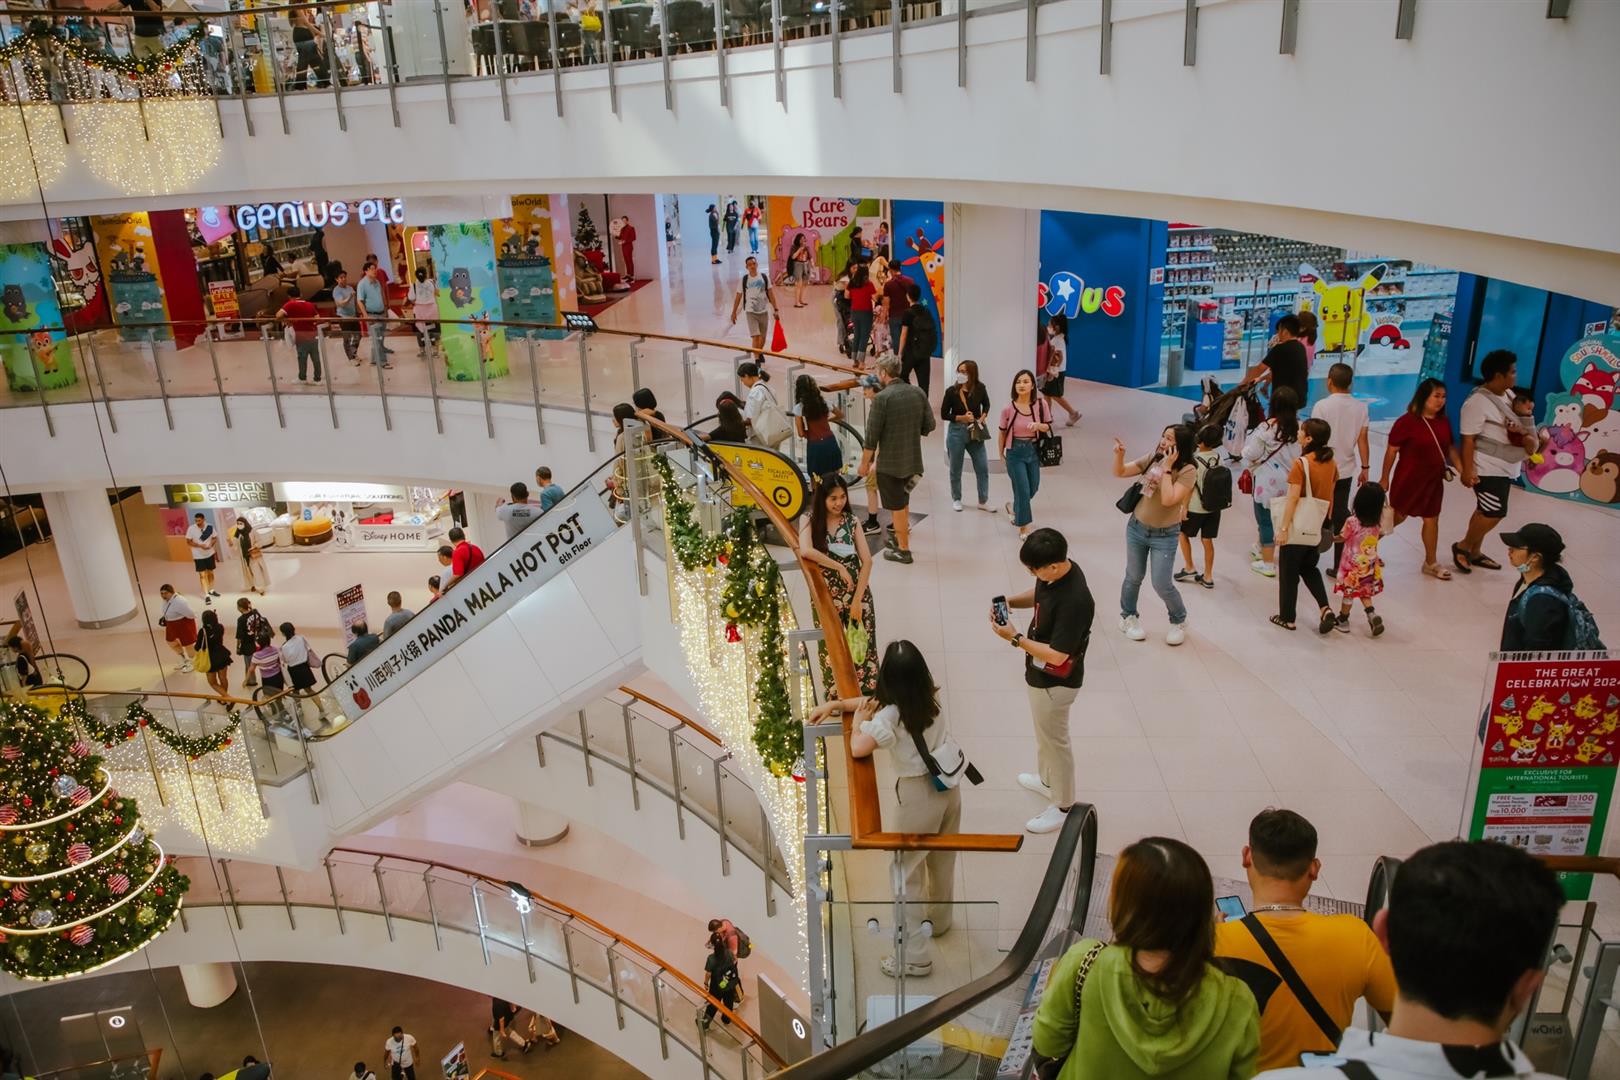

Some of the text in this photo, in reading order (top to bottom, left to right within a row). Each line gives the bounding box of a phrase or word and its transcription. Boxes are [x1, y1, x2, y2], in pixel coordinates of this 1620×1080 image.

[809, 196, 845, 214] Care
[802, 211, 848, 229] Bears
[207, 482, 266, 492] DESIGN
[208, 492, 270, 502] SQUARE
[390, 532, 421, 541] HOME
[558, 538, 593, 565] 6th Floor
[417, 608, 468, 652] PANDA
[463, 572, 514, 616] MALA
[509, 541, 547, 583] HOT
[545, 512, 585, 554] POT
[1535, 668, 1601, 678] THE GREAT
